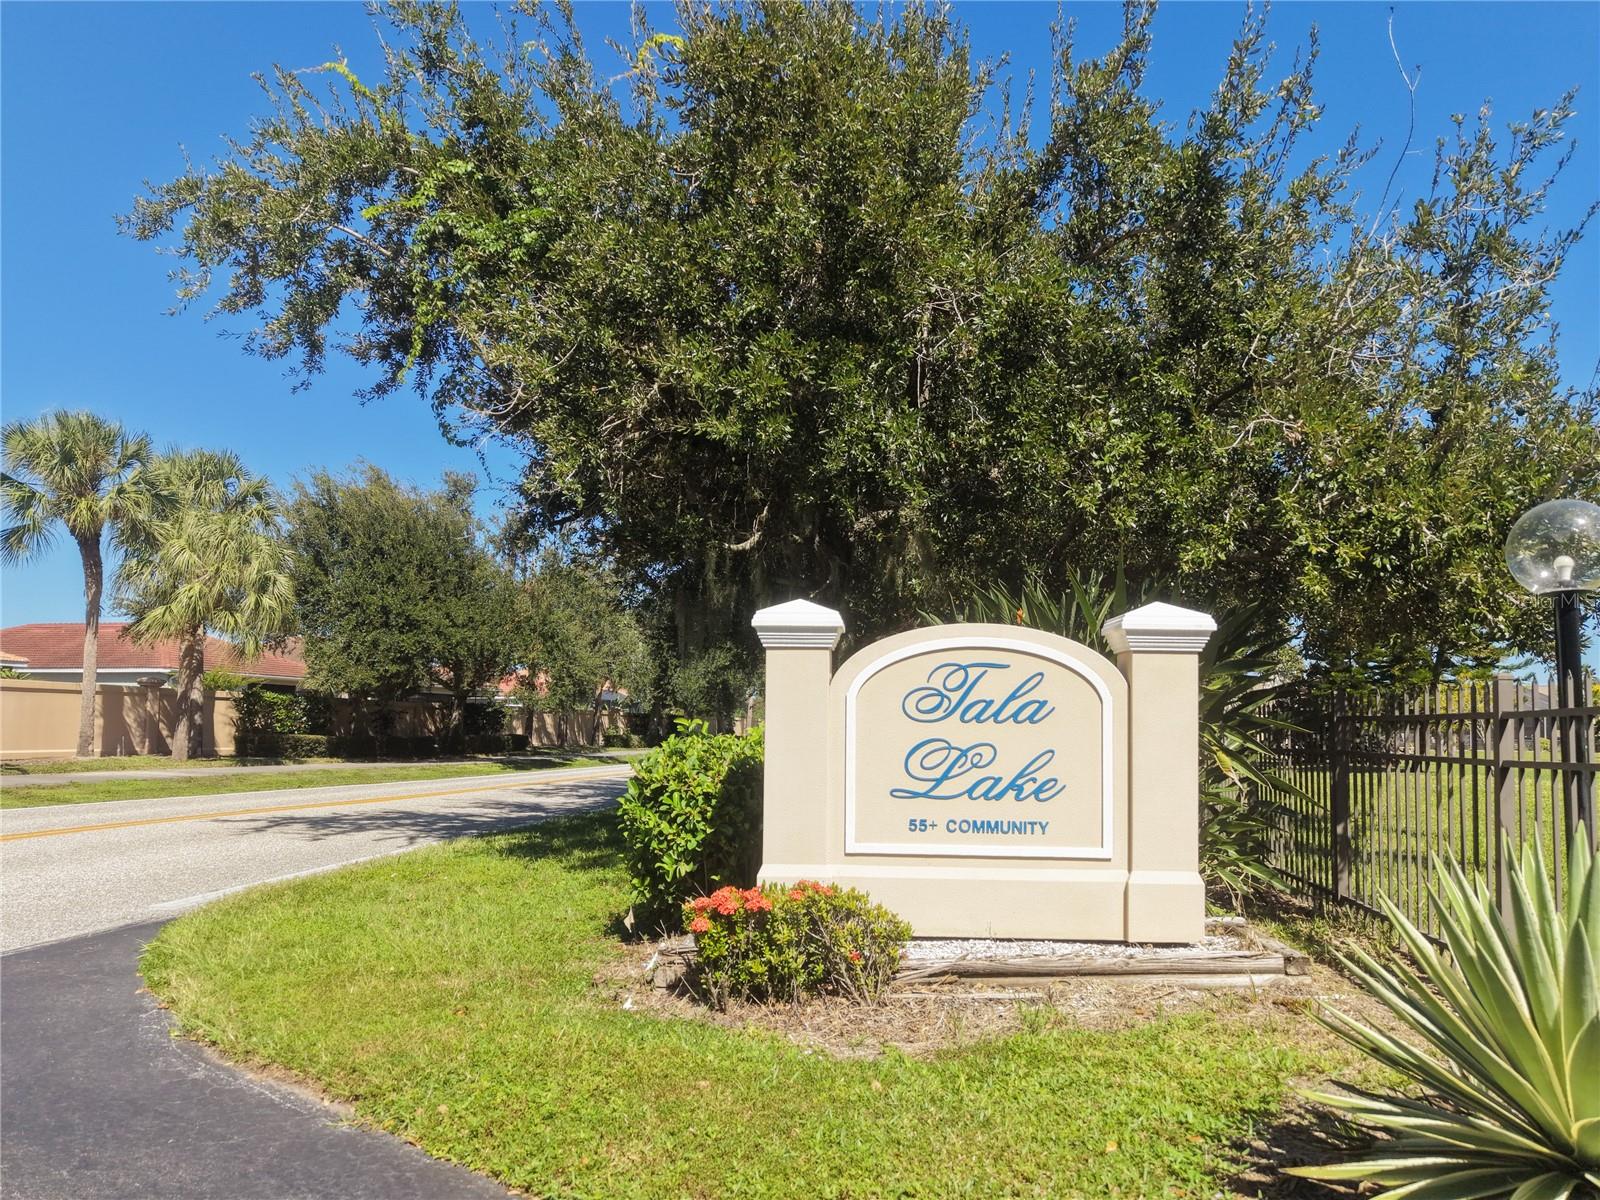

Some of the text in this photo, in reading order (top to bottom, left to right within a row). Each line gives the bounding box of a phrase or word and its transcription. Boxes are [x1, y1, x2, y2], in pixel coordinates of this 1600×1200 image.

[902, 662, 1056, 725] Tala
[890, 737, 1066, 804] Lake
[908, 817, 1050, 835] 55+ COMMUNITY
